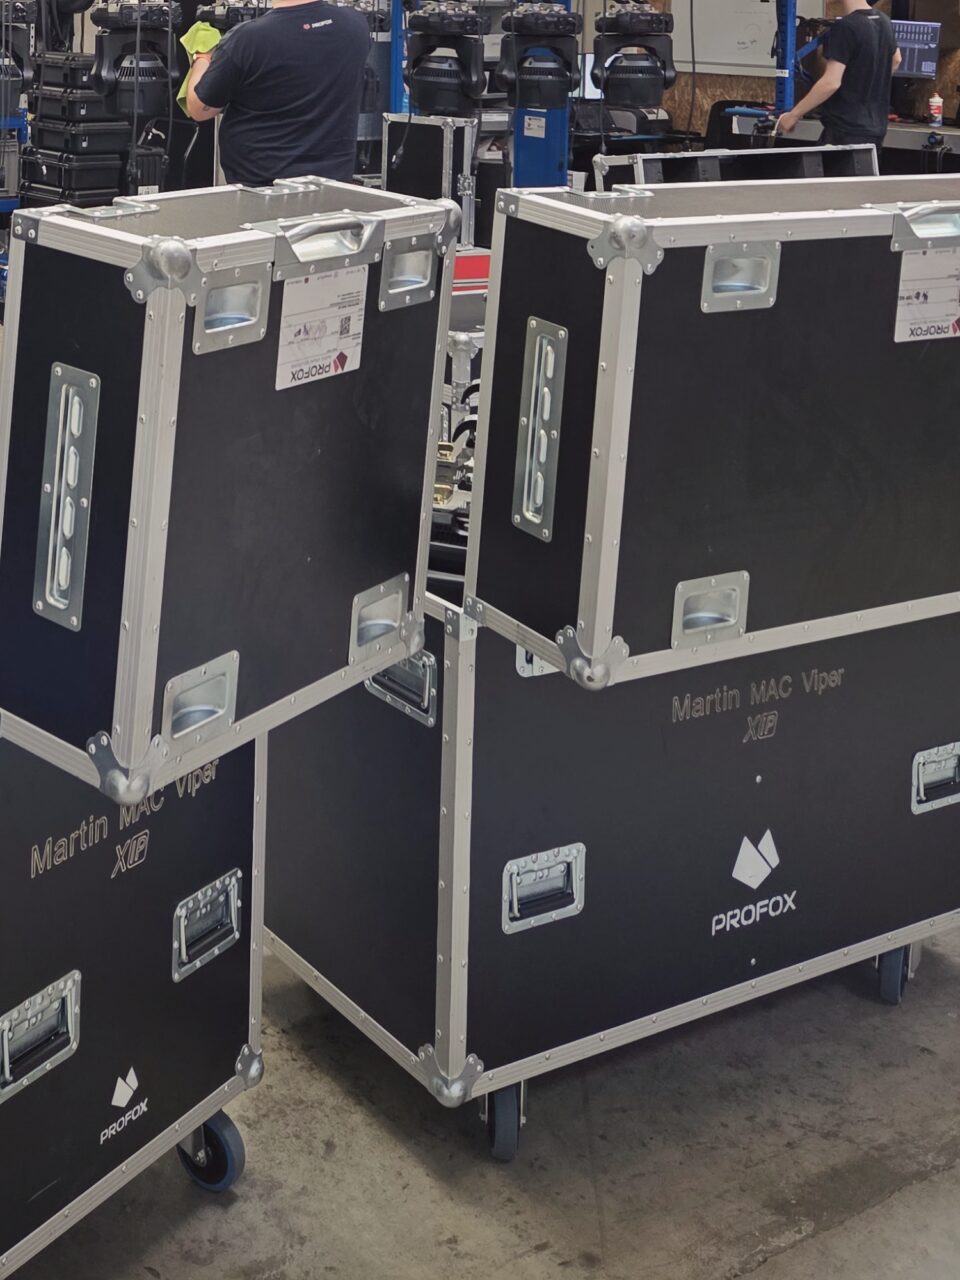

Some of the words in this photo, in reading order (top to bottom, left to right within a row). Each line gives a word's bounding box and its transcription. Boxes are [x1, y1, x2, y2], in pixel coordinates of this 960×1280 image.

[909, 325, 950, 337] PROFOX
[290, 361, 331, 382] PROFOX
[672, 685, 741, 723] Martin
[750, 675, 793, 705] MAC
[801, 667, 845, 696] Viper
[30, 815, 108, 879] Martin
[120, 789, 165, 830] MAC
[175, 758, 220, 799] Viper
[711, 890, 797, 937] PROFOX
[99, 1097, 149, 1145] PROFOX
